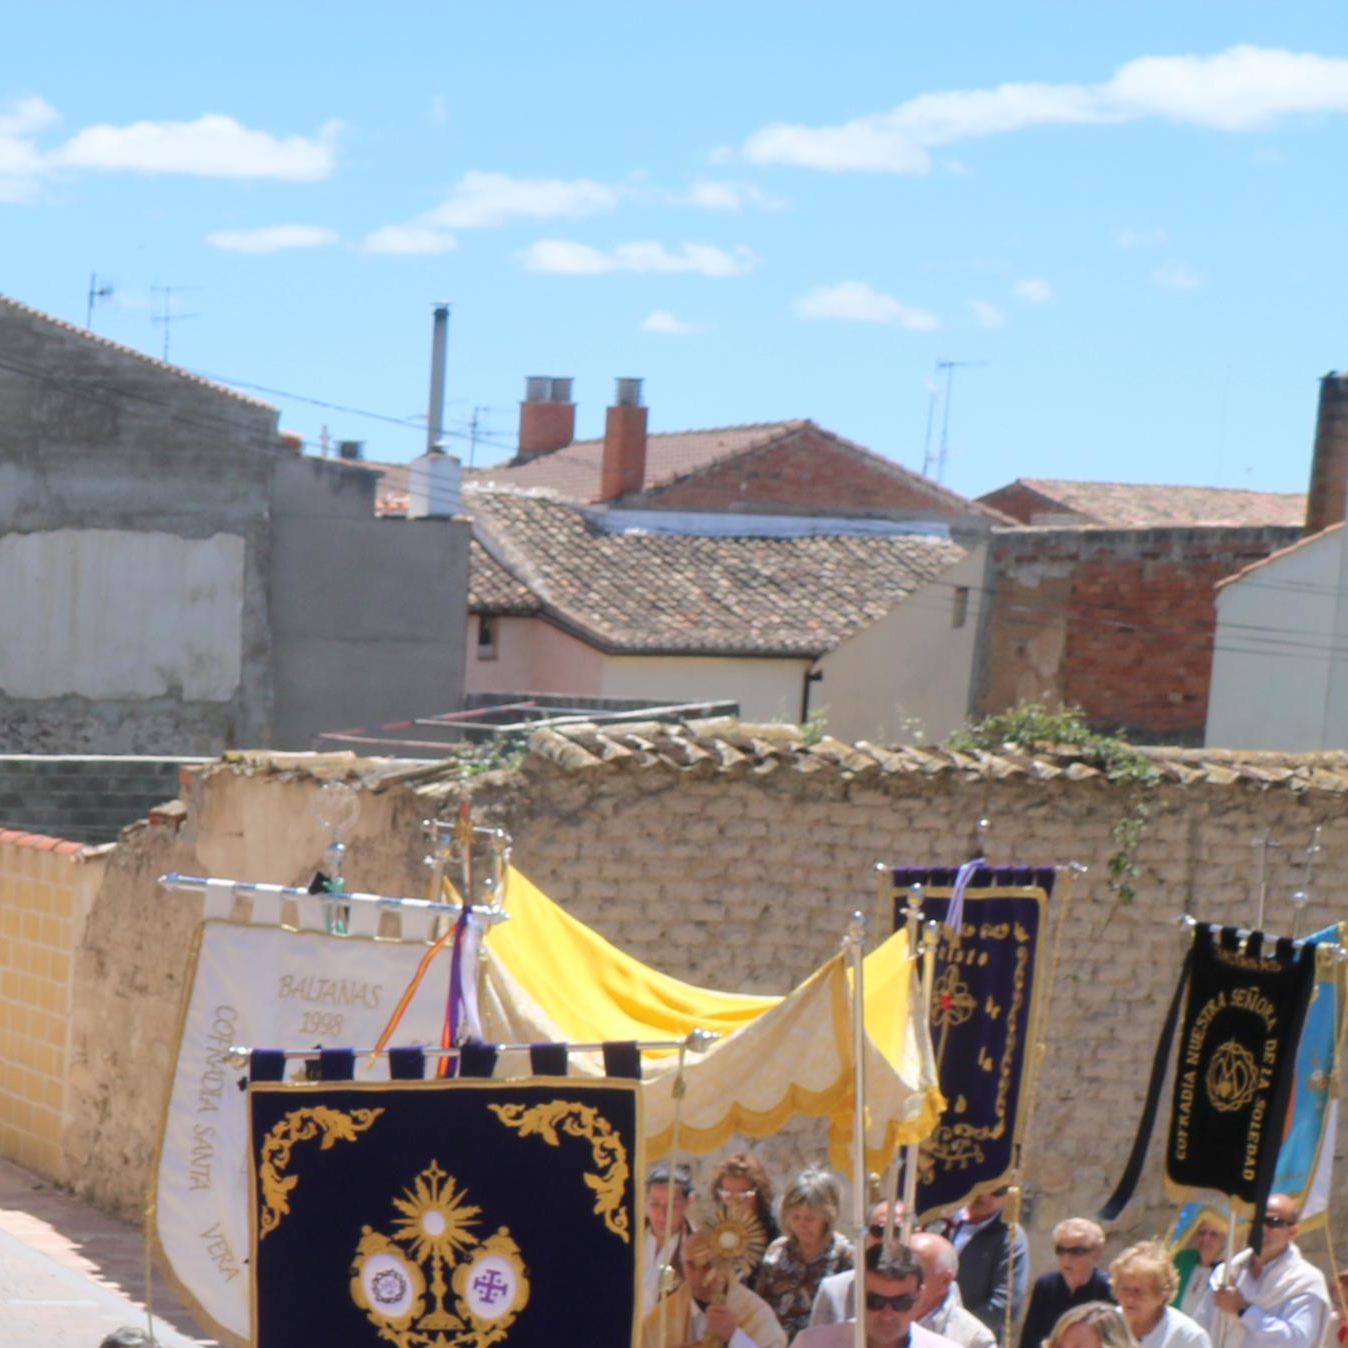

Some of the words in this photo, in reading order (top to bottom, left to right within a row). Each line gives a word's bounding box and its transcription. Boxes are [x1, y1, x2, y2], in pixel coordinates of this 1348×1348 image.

[298, 1011, 345, 1036] 1998
[1186, 991, 1226, 1066] NUESTRA
[1230, 986, 1278, 1032] SEÑORA
[1263, 1038, 1278, 1063] DE
[1258, 1066, 1272, 1090] LA
[189, 1124, 217, 1192] SANTA
[1243, 1096, 1266, 1182] SOLEDAD
[201, 1222, 240, 1283] VERA
